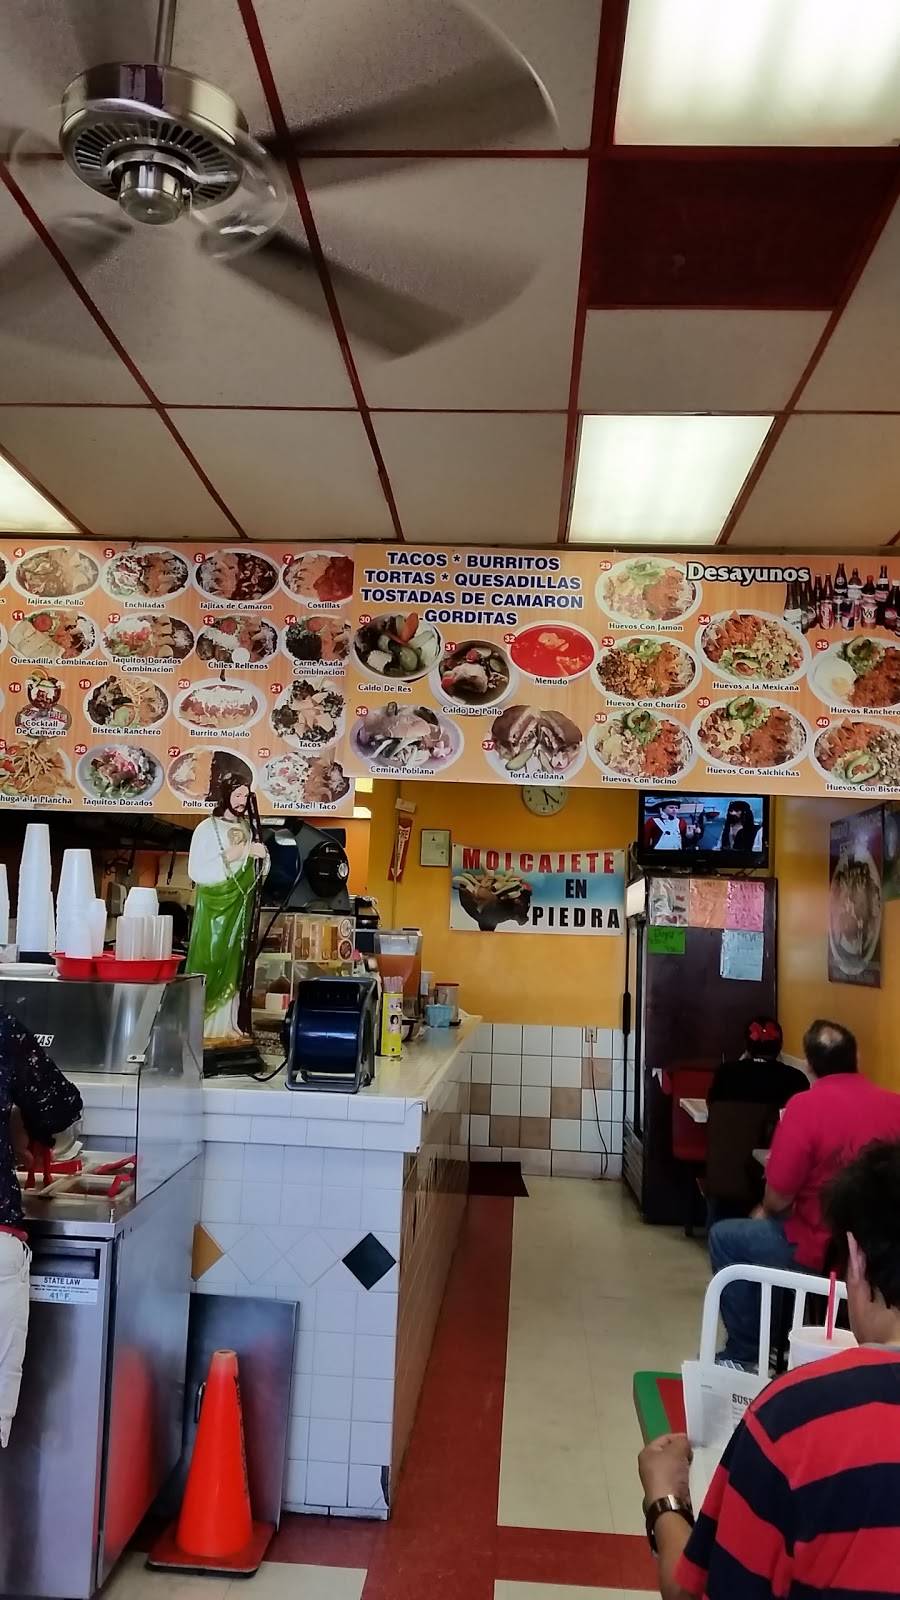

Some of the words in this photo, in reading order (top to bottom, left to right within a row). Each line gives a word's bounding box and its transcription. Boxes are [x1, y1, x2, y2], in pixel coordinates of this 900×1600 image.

[196, 554, 202, 562] 6
[388, 552, 447, 566] TACOS
[467, 555, 560, 570] BURRITOS
[365, 570, 435, 584] TORTAS
[455, 573, 581, 589] QUESADILLAS
[687, 562, 810, 586] Desayunos
[361, 588, 455, 604] TOSTADAS
[461, 592, 485, 605] DE
[492, 594, 583, 608] CAMARON
[11, 657, 53, 665] Quesadilla
[713, 682, 742, 690] Huevos
[655, 701, 686, 709] Chorizo
[221, 730, 250, 738] Mojado
[371, 766, 399, 774] Cemita
[402, 767, 434, 775] Poblana
[84, 798, 116, 806] Taquitos
[463, 848, 615, 874] MOLCAJETE
[565, 879, 587, 899] EN
[532, 906, 620, 928] PIEDRA
